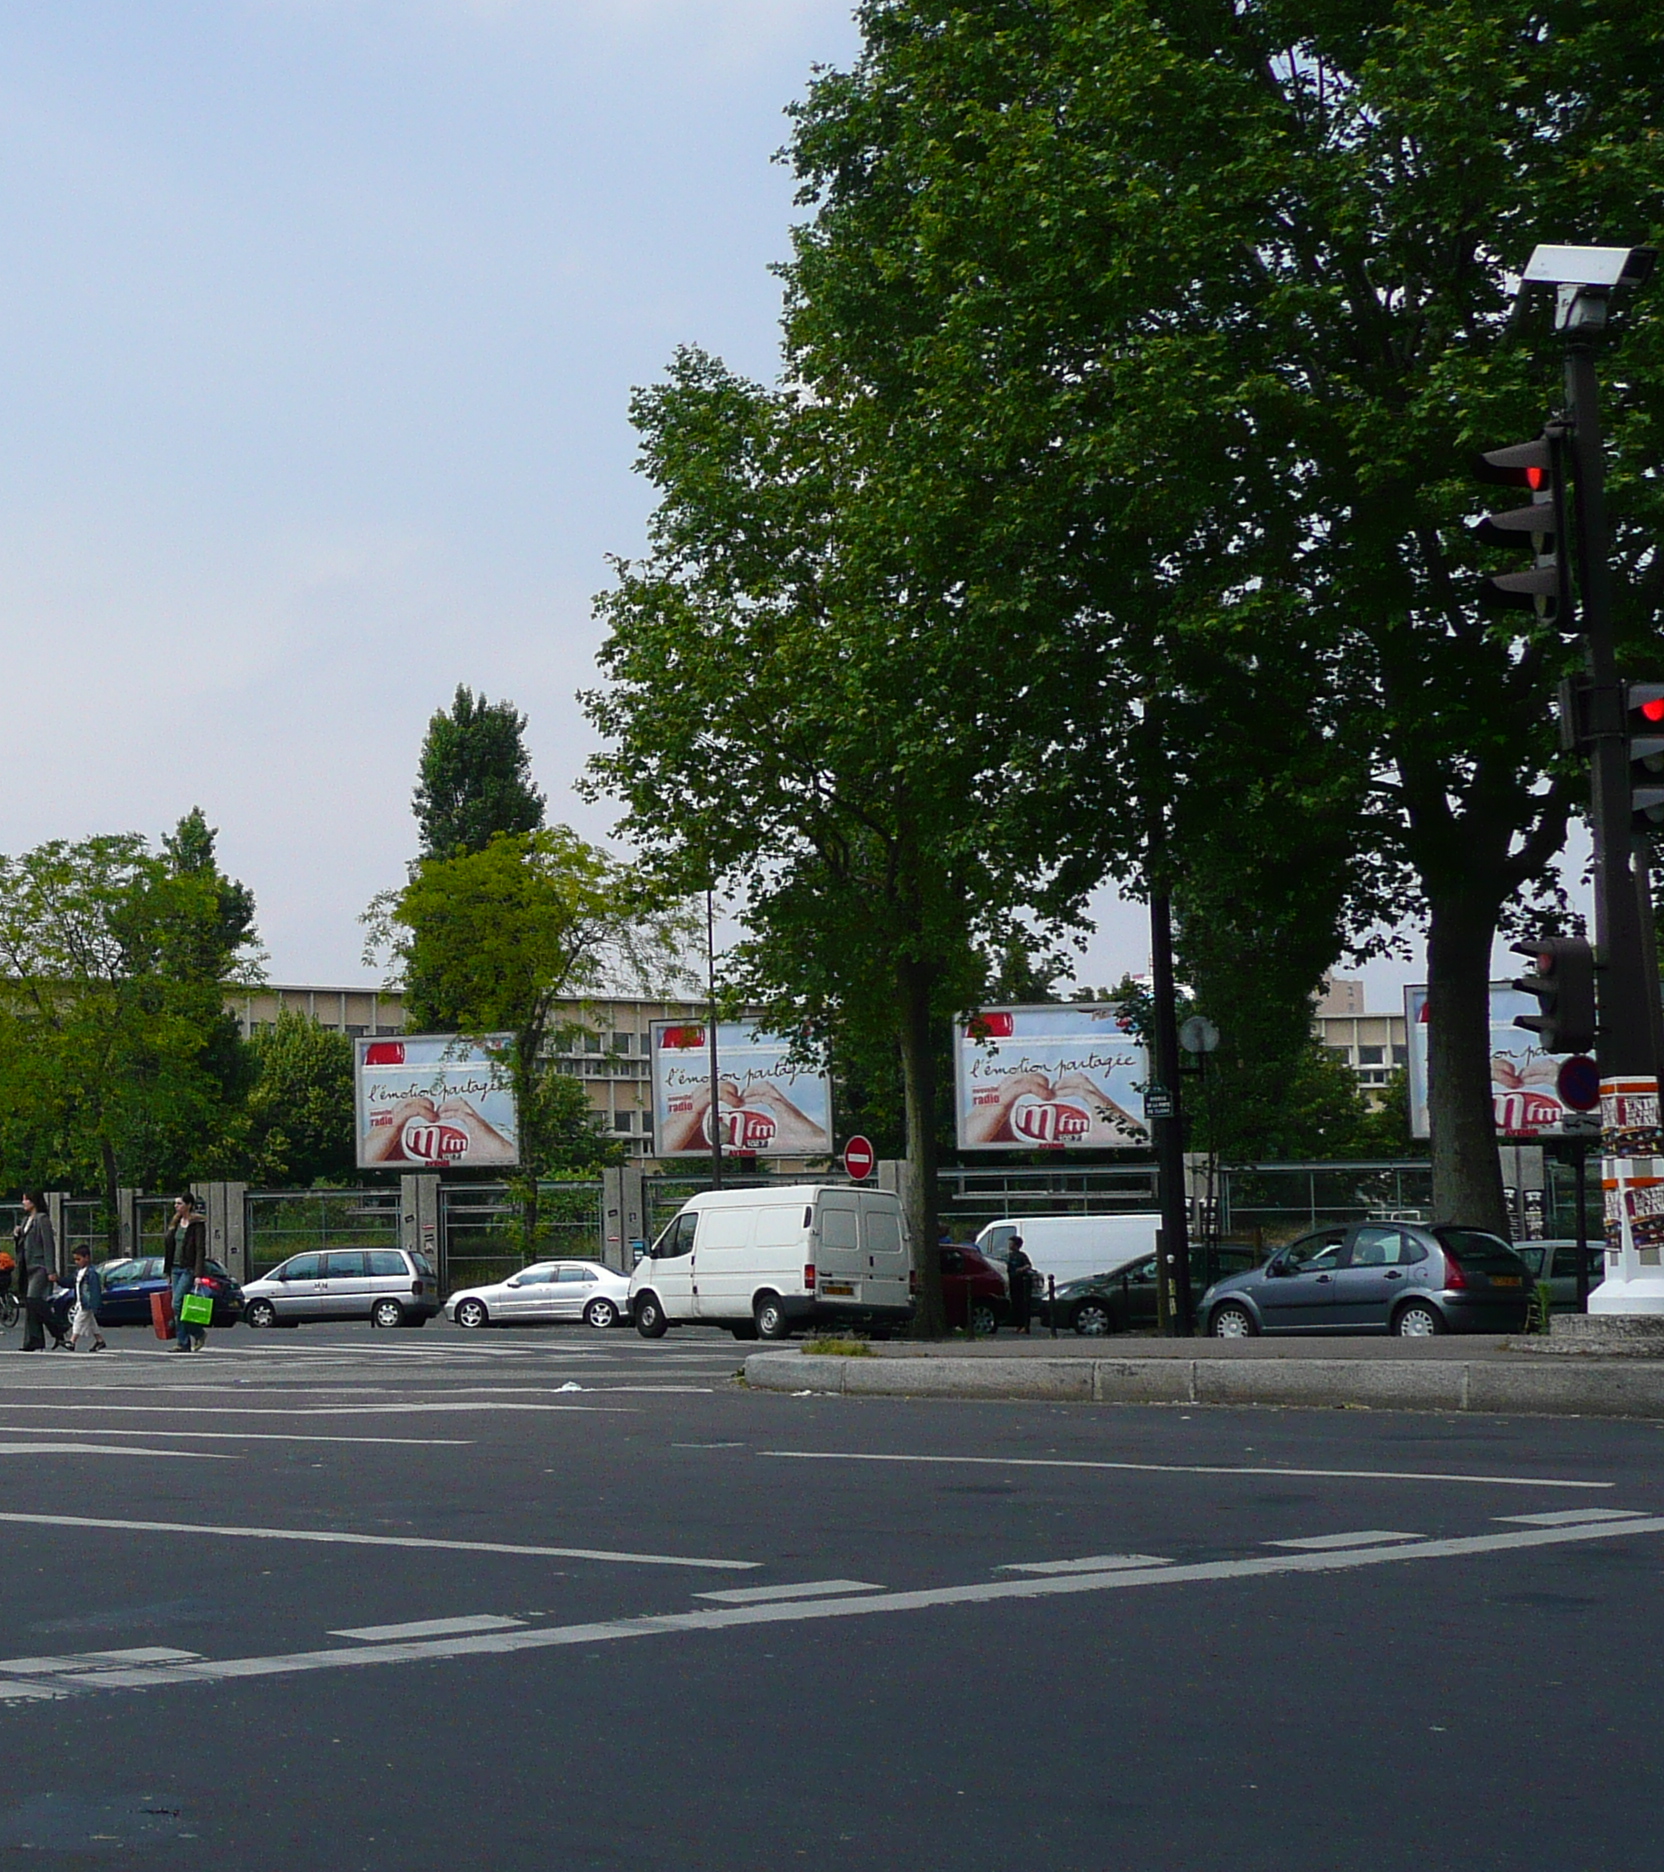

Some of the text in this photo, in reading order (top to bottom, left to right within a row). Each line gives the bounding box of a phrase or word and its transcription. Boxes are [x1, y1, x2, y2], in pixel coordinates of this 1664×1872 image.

[970, 1052, 1136, 1079] l'émotion partagée
[972, 1094, 1000, 1105] radio
[668, 1101, 693, 1113] radio
[370, 1116, 393, 1127] radio
